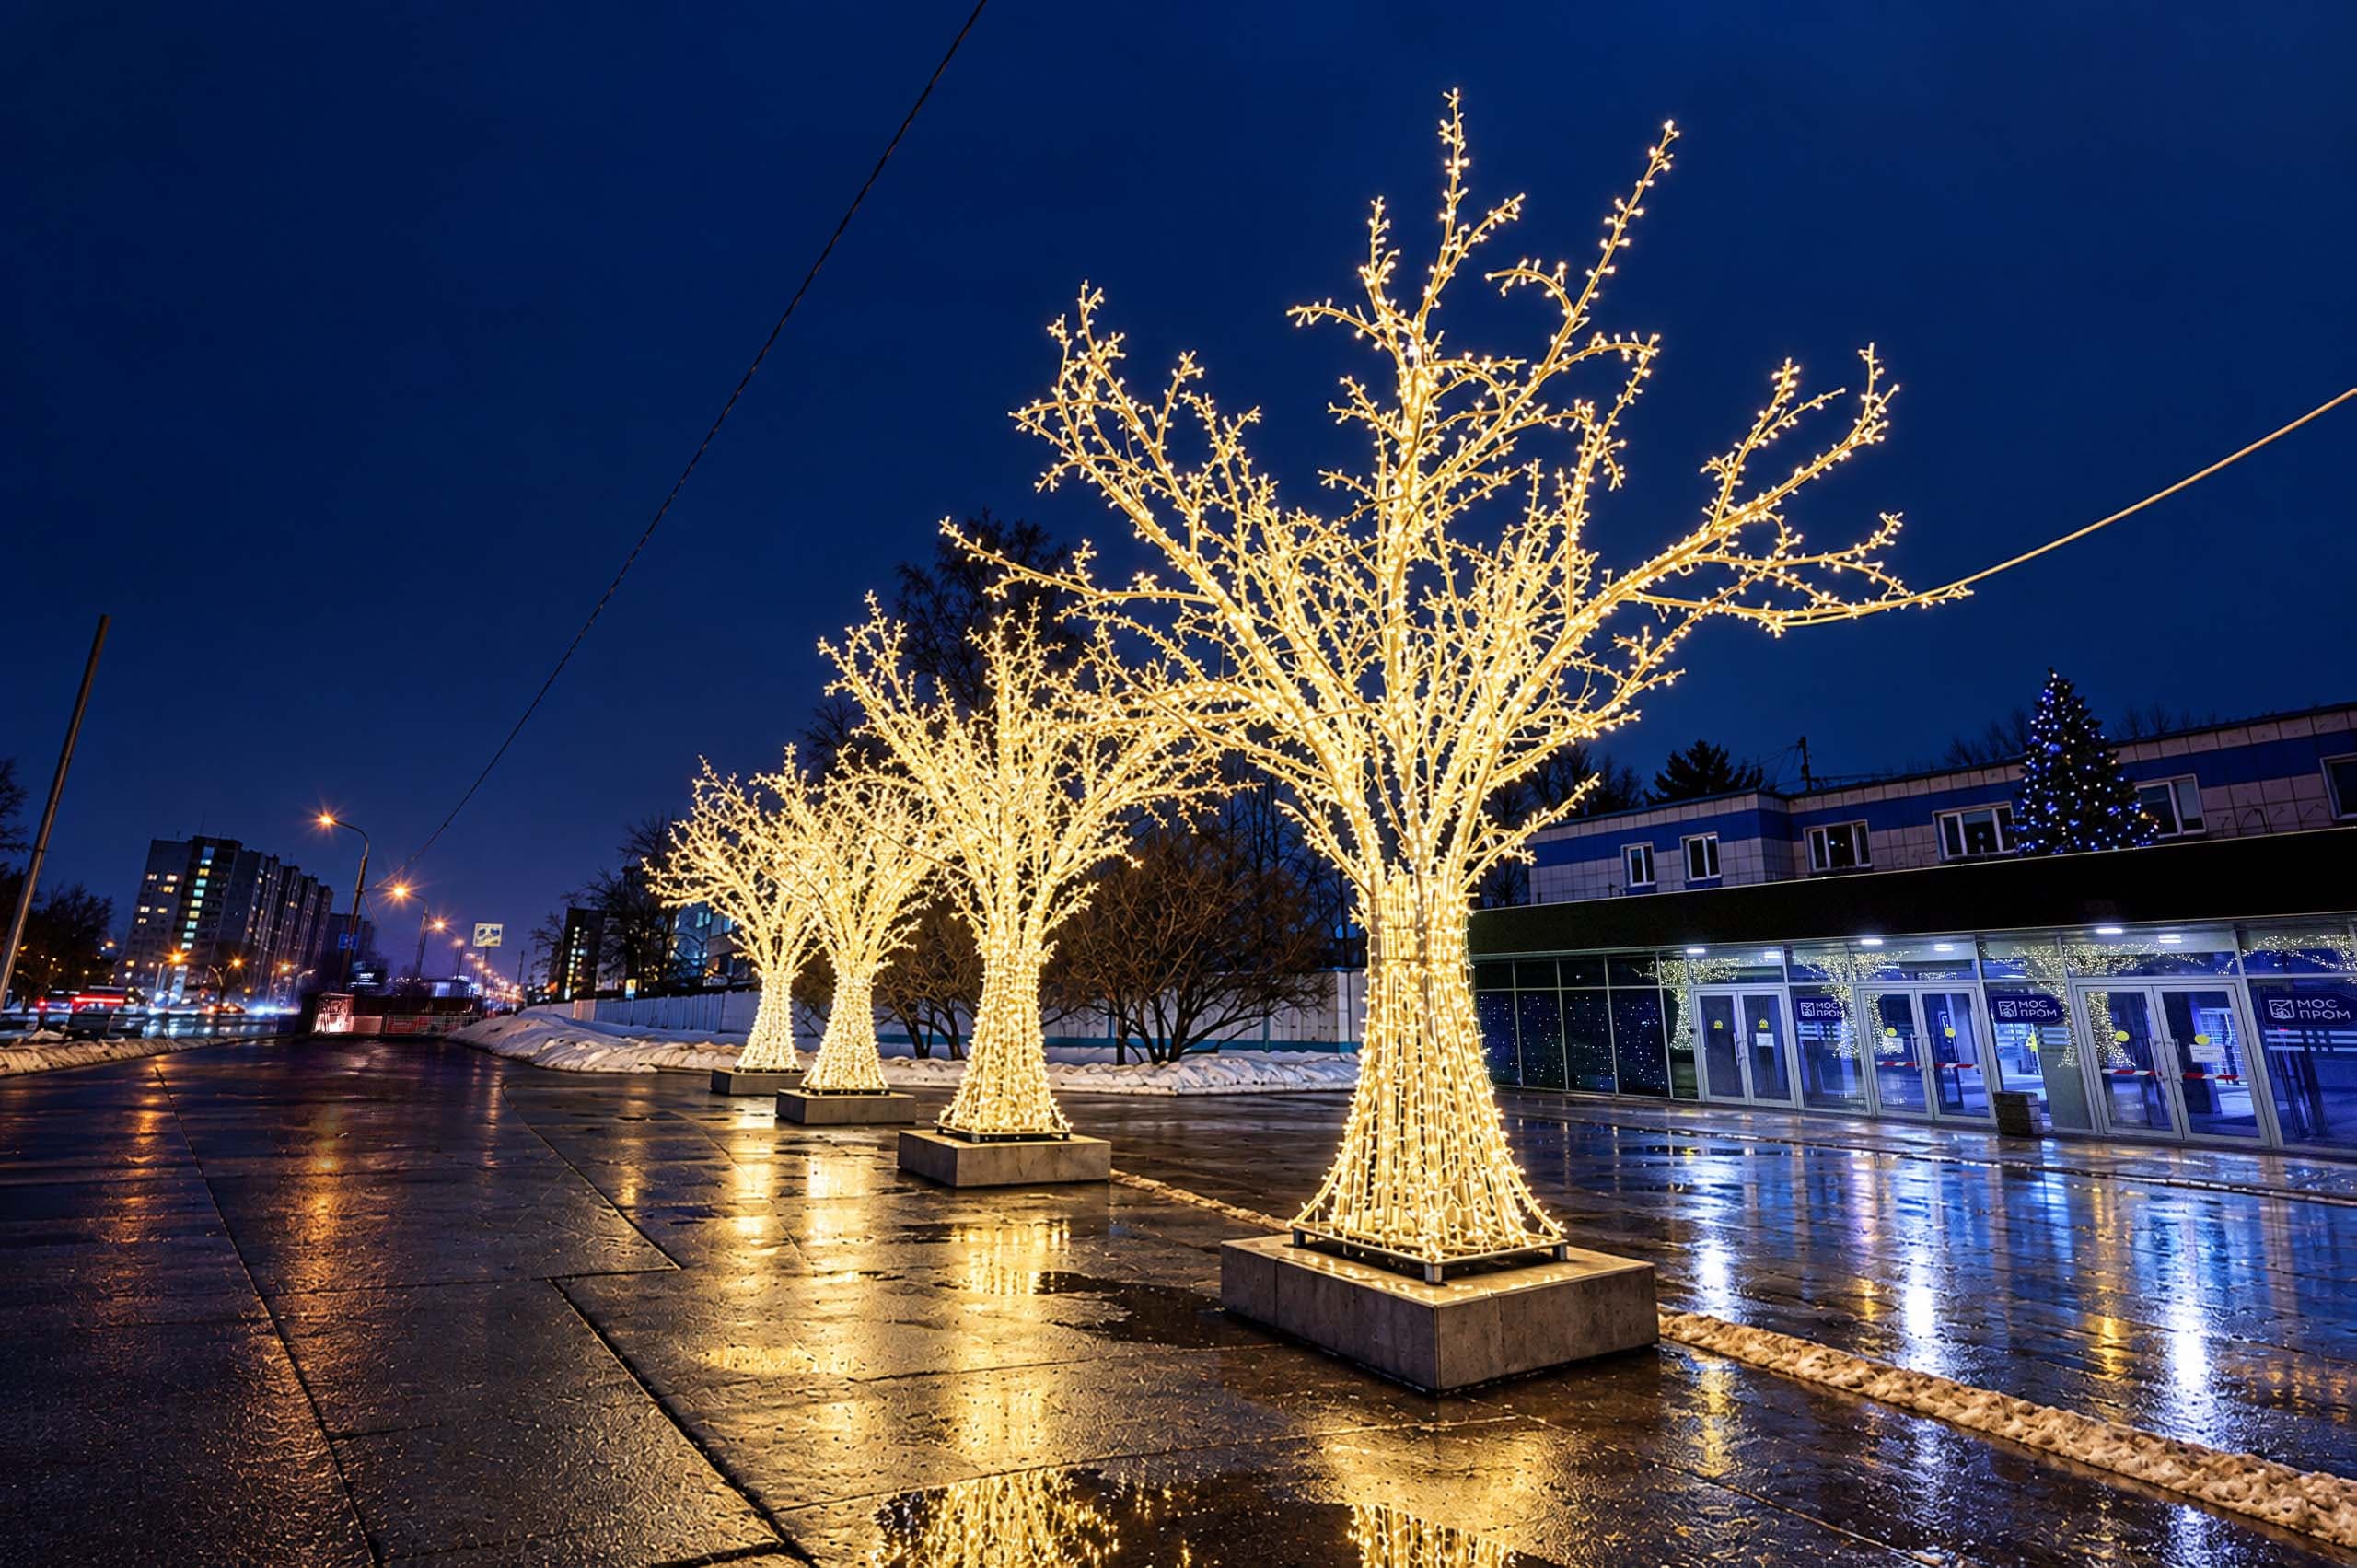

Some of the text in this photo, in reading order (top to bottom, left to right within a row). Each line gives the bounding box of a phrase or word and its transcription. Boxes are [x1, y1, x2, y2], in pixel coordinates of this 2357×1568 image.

[2297, 999, 2338, 1008] МОС
[2020, 1009, 2057, 1017] ПРОМ
[2300, 1010, 2351, 1019] ПРОМ
